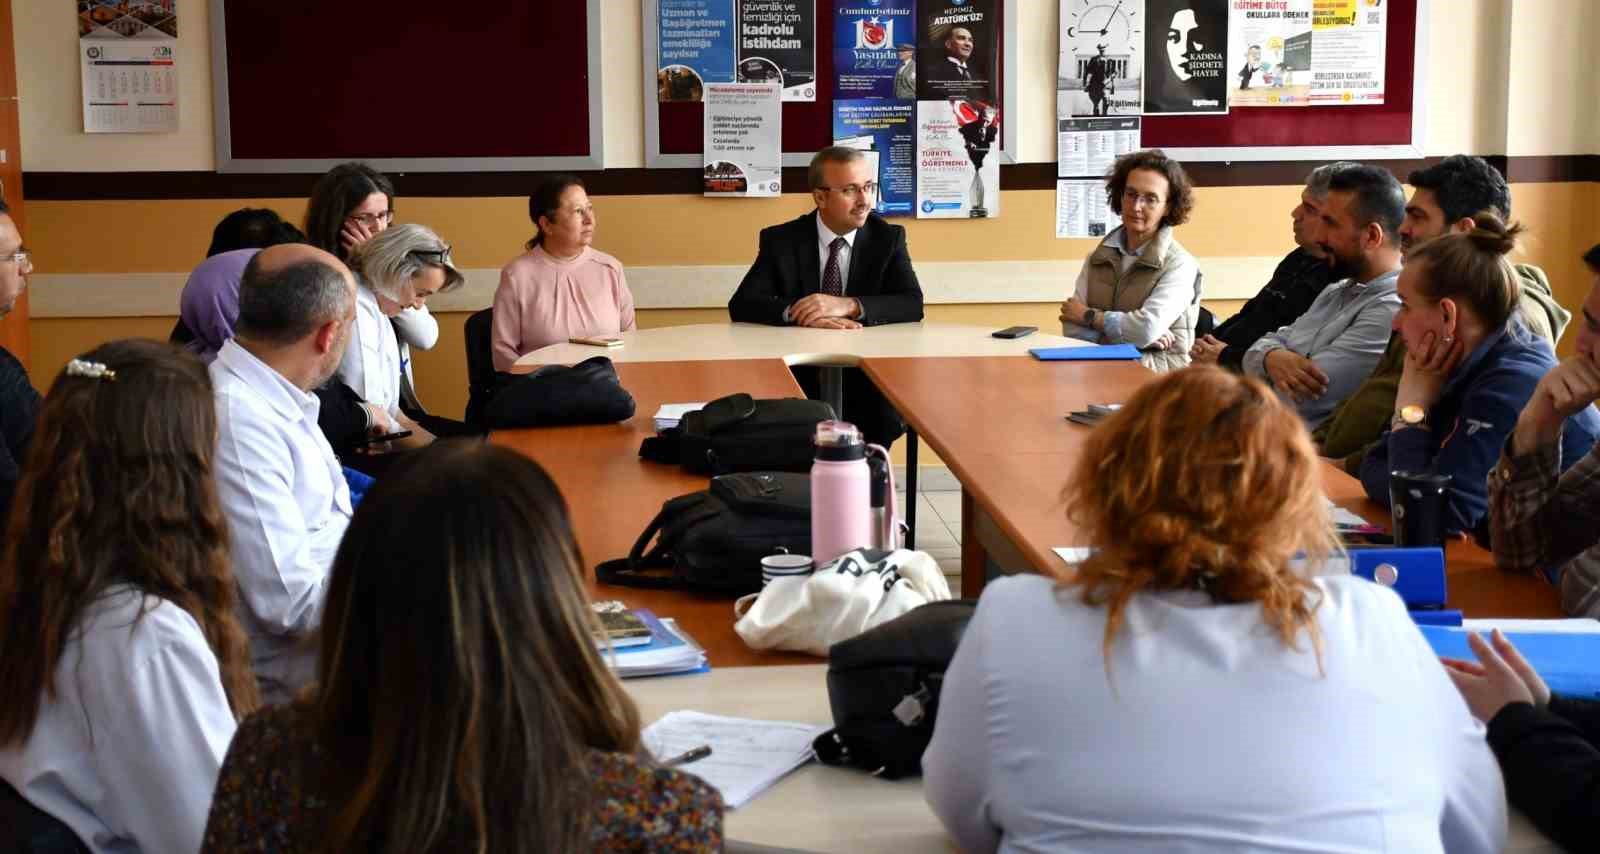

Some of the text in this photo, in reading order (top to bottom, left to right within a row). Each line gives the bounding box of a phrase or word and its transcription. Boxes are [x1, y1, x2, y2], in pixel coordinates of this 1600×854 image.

[743, 2, 783, 13] güvenlik
[839, 7, 911, 17] Cumhuriyetimiz
[944, 6, 974, 15] HEPİMİZ
[743, 12, 801, 23] temizliği için
[1282, 10, 1309, 18] ÖDENEK
[743, 23, 794, 35] kadrolu
[743, 37, 801, 49] istihdam
[853, 50, 897, 60] Yaşında
[1190, 52, 1222, 60] KADINA
[1189, 60, 1224, 70] ŞİDDETE
